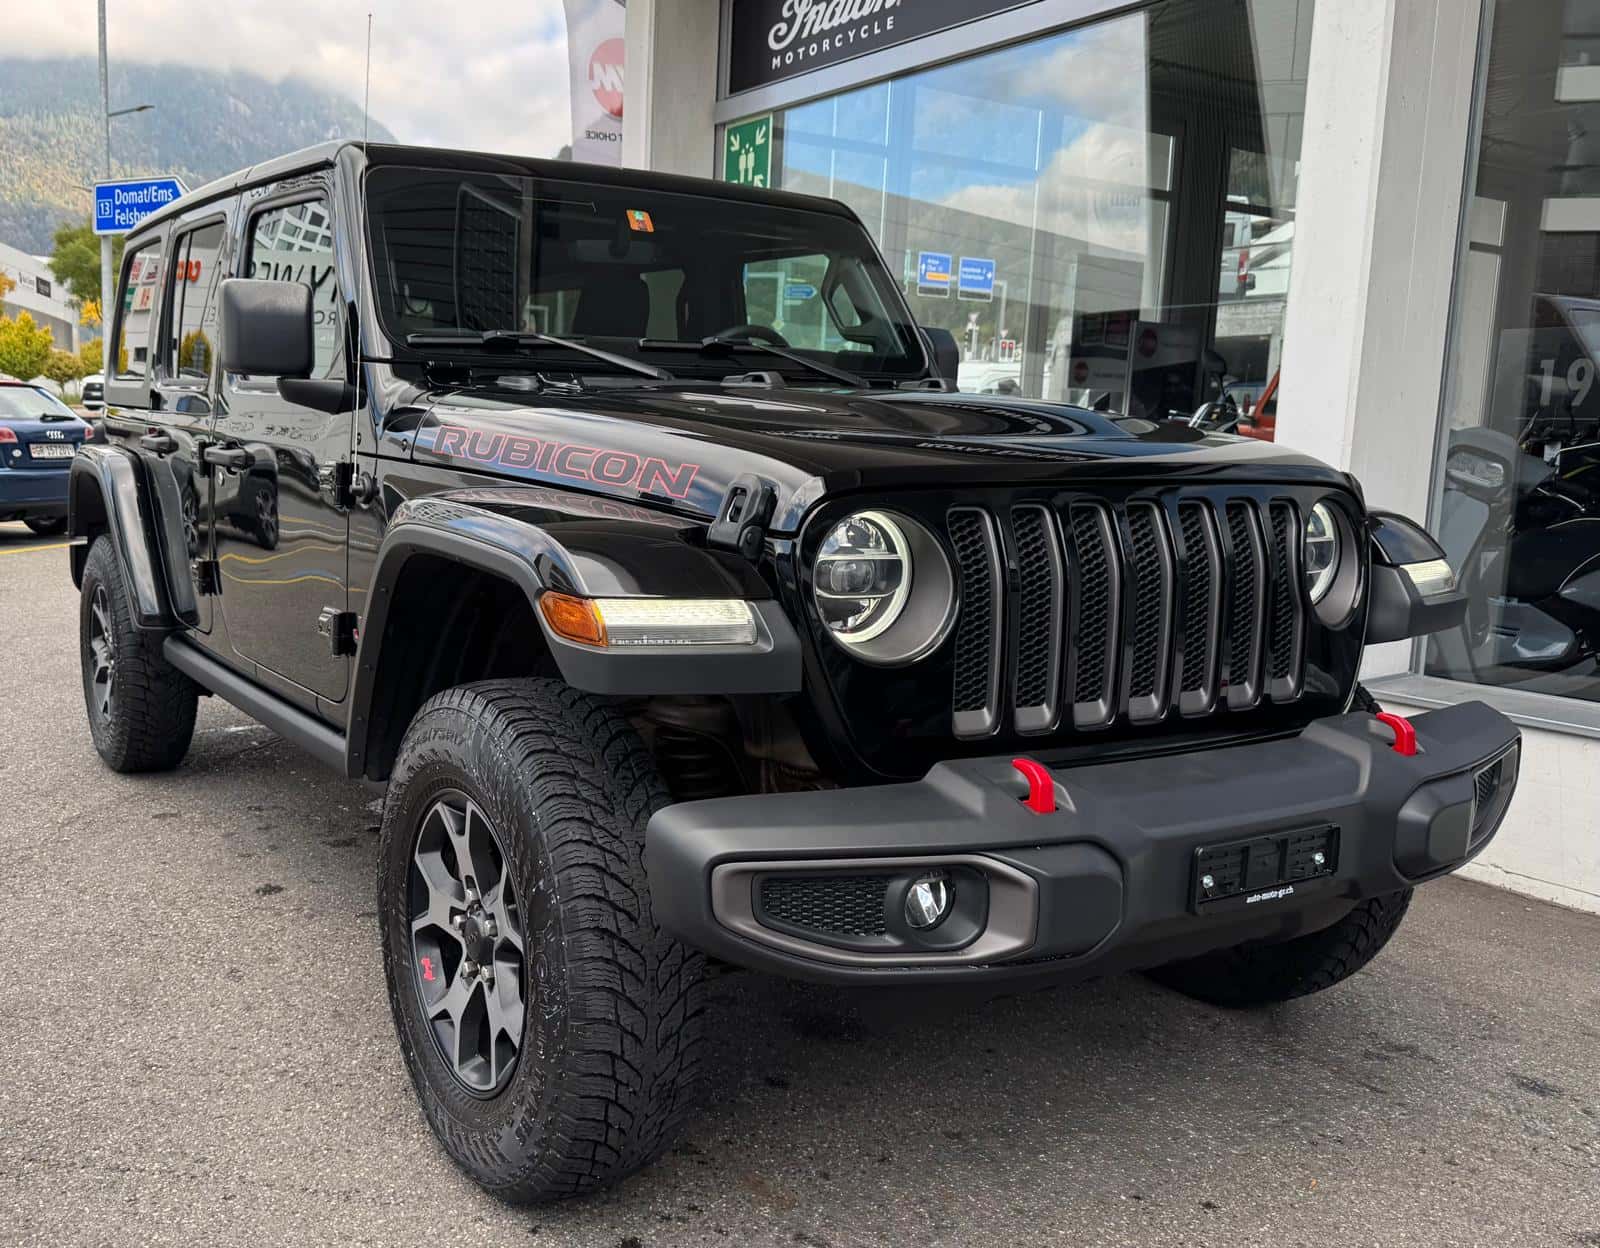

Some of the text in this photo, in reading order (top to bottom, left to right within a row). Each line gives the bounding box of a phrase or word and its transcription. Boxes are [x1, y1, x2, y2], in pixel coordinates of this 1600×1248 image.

[772, 16, 895, 70] MOTORCYCLE
[100, 202, 110, 215] 13
[114, 186, 174, 205] Domat/Ems
[431, 424, 700, 499] RUBICON
